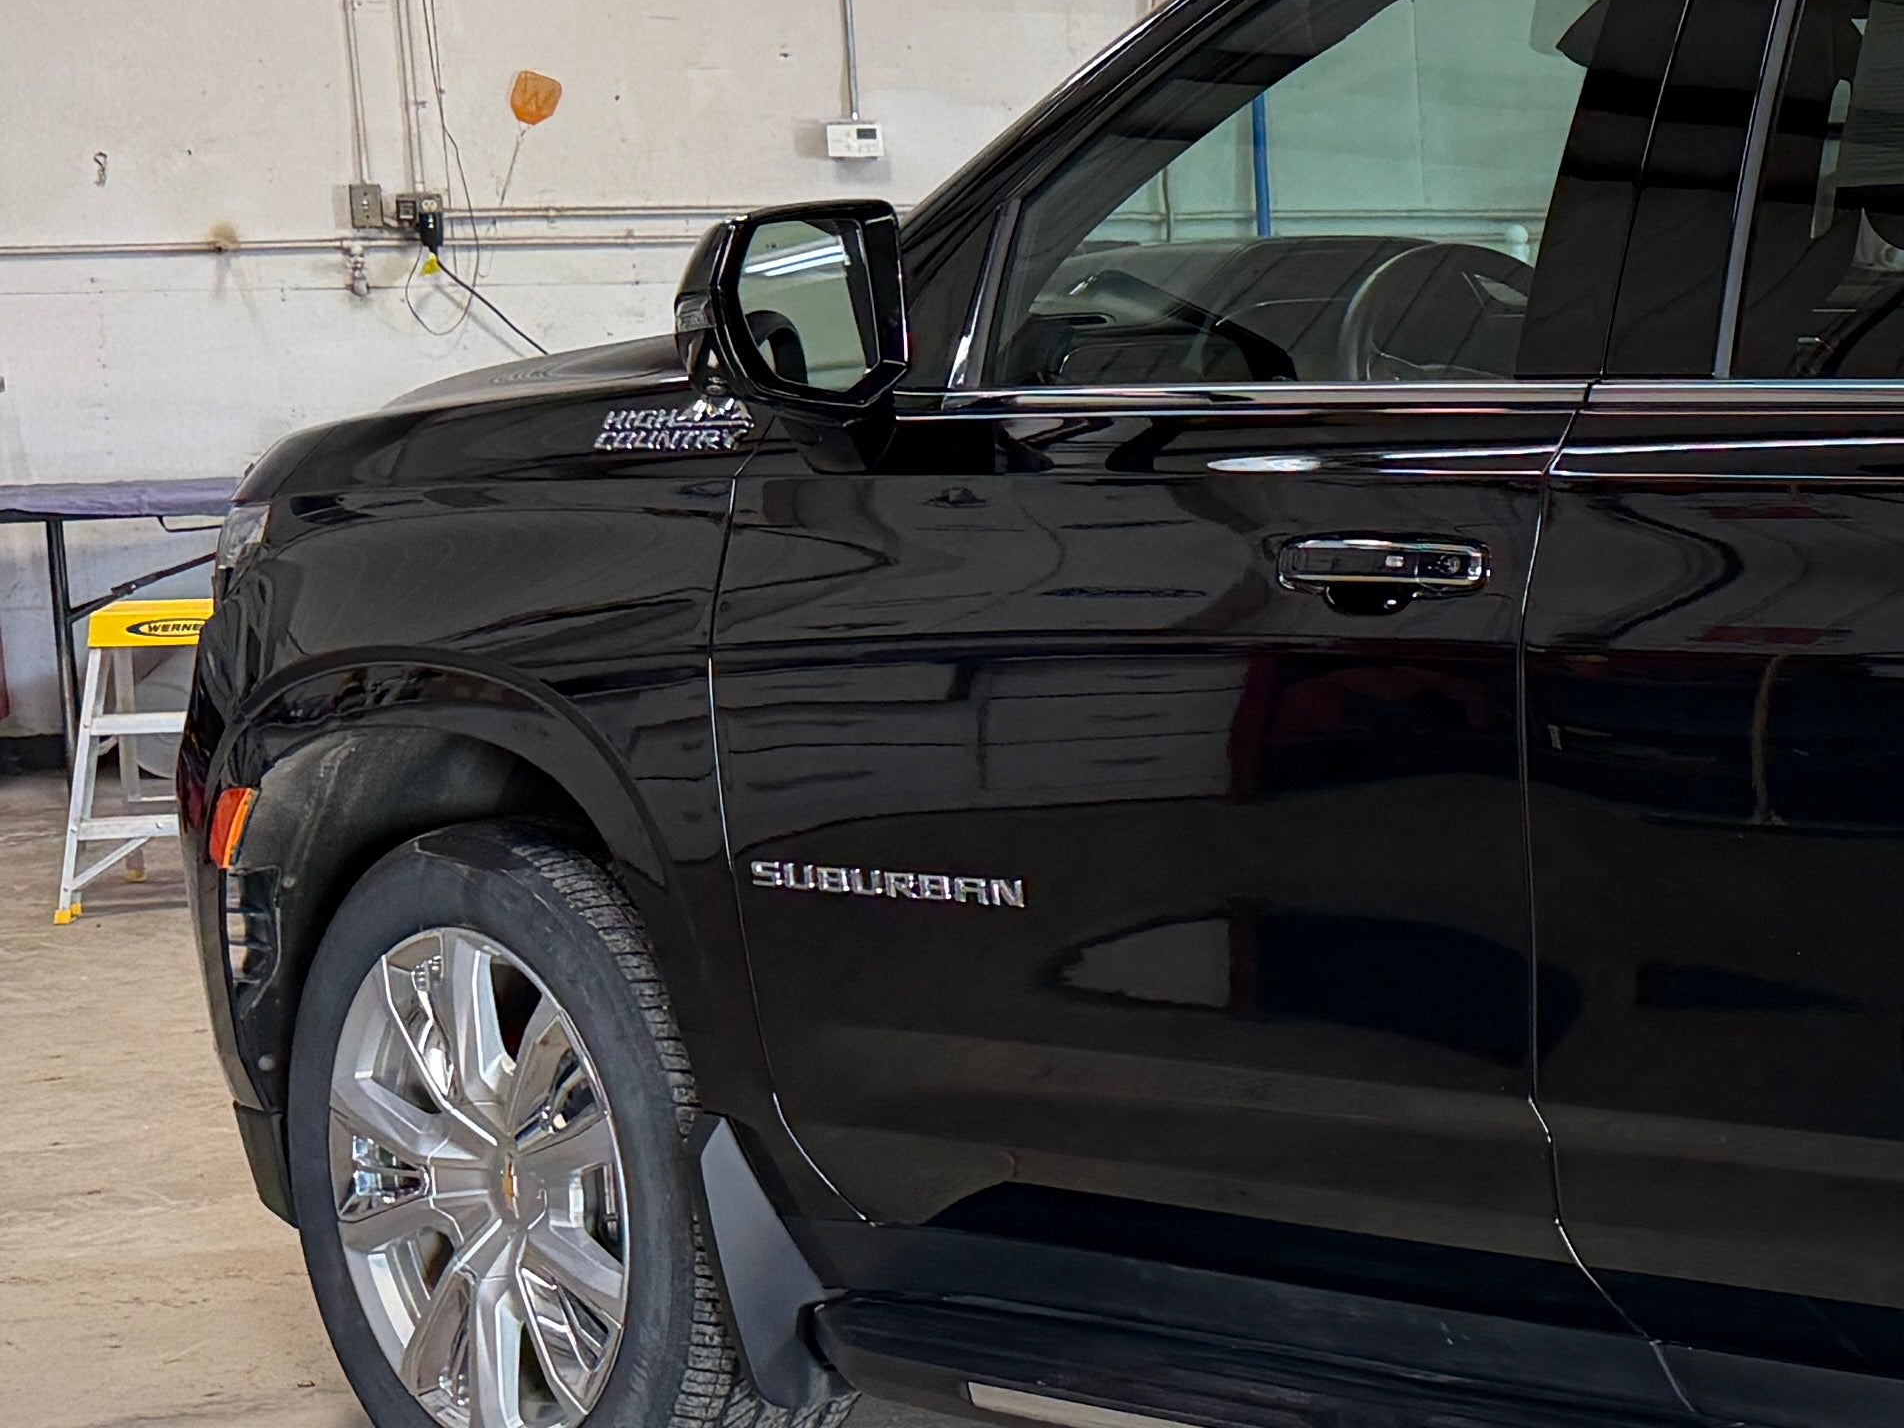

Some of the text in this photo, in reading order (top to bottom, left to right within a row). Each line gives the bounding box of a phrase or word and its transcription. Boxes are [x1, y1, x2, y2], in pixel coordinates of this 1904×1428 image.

[602, 409, 678, 429] HIGH
[594, 429, 747, 450] COUNTRY
[148, 623, 203, 632] WERNE
[751, 860, 1026, 908] SUBURBAN
